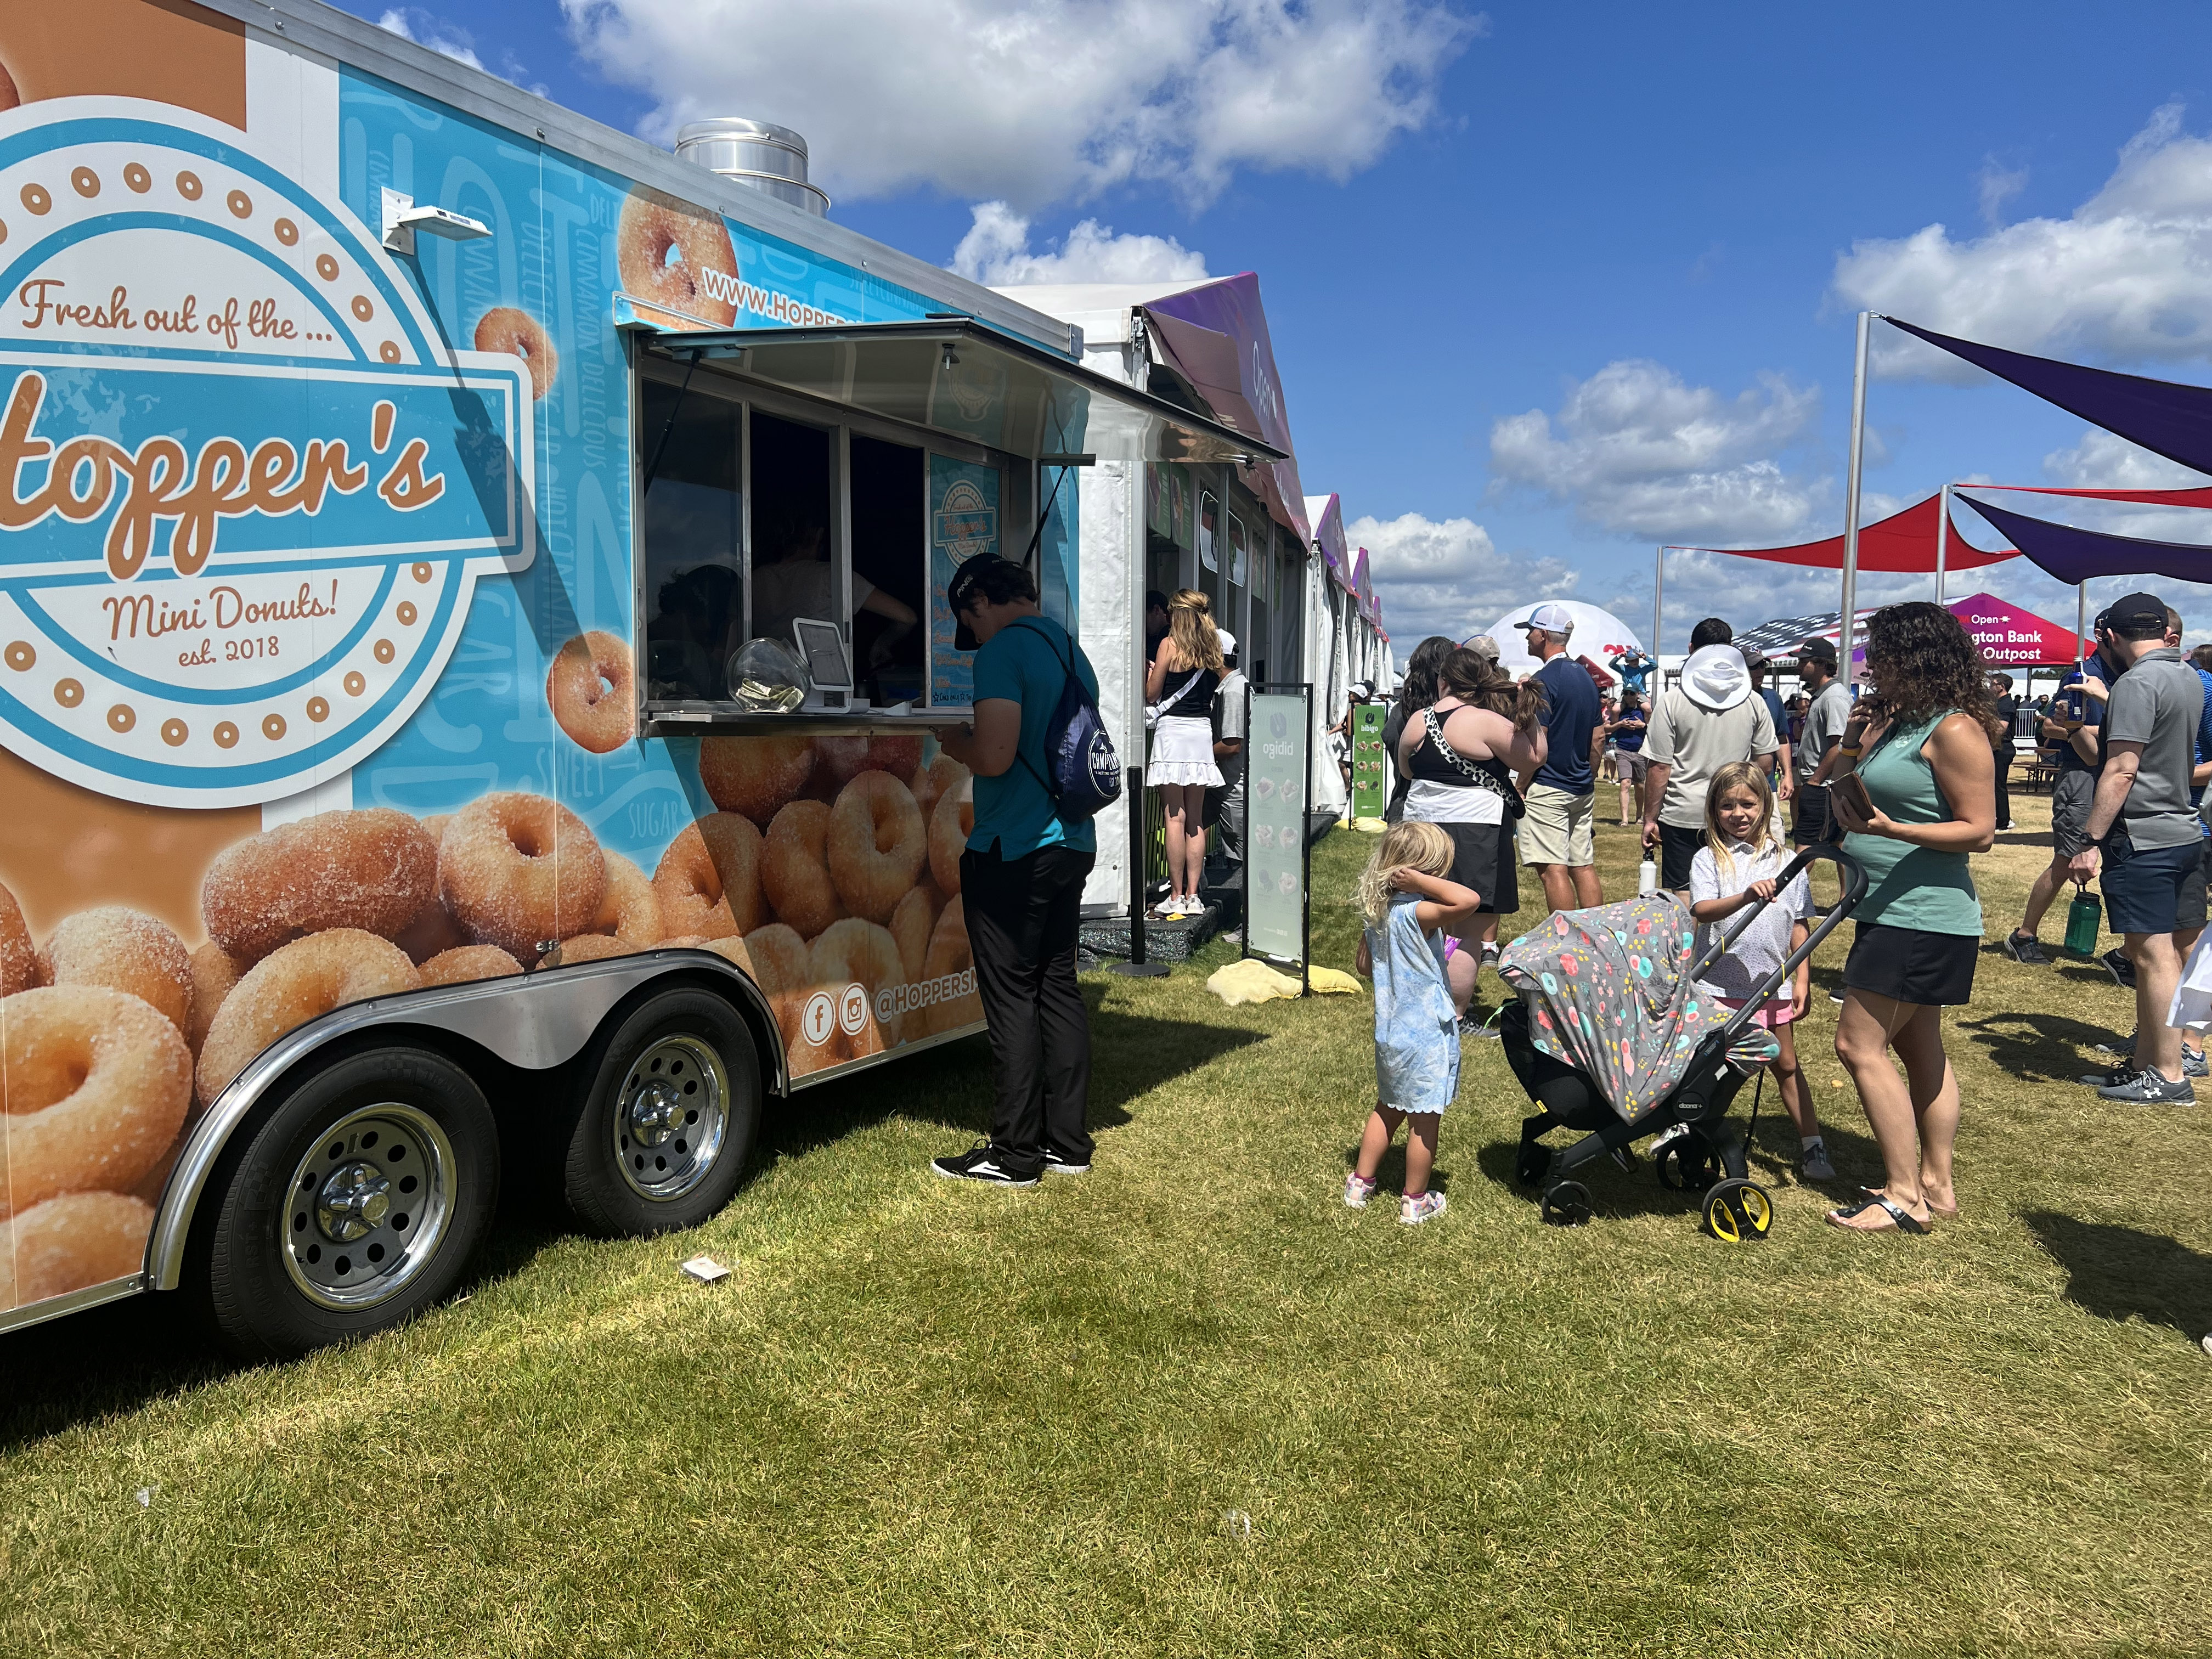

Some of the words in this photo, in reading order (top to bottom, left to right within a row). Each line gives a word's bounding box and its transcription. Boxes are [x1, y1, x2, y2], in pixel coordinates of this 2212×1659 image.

[574, 228, 604, 356] CINNAMON
[19, 279, 137, 329] Fresh
[144, 294, 199, 334] out
[207, 298, 245, 350] of
[247, 298, 298, 341] the
[580, 363, 608, 469] DELICIOUS
[944, 515, 987, 541] Hopper's
[956, 574, 973, 597] PING
[103, 592, 207, 641] Mini
[210, 579, 338, 630] Donuts!
[1971, 614, 1999, 625] Open
[178, 639, 216, 668] est.
[225, 635, 280, 661] 2018
[2007, 630, 2042, 643] Bank
[1983, 647, 2041, 662] Outpost
[1361, 724, 1379, 733] bibigo
[537, 747, 606, 799] SWEET
[629, 800, 682, 840] SUGAR
